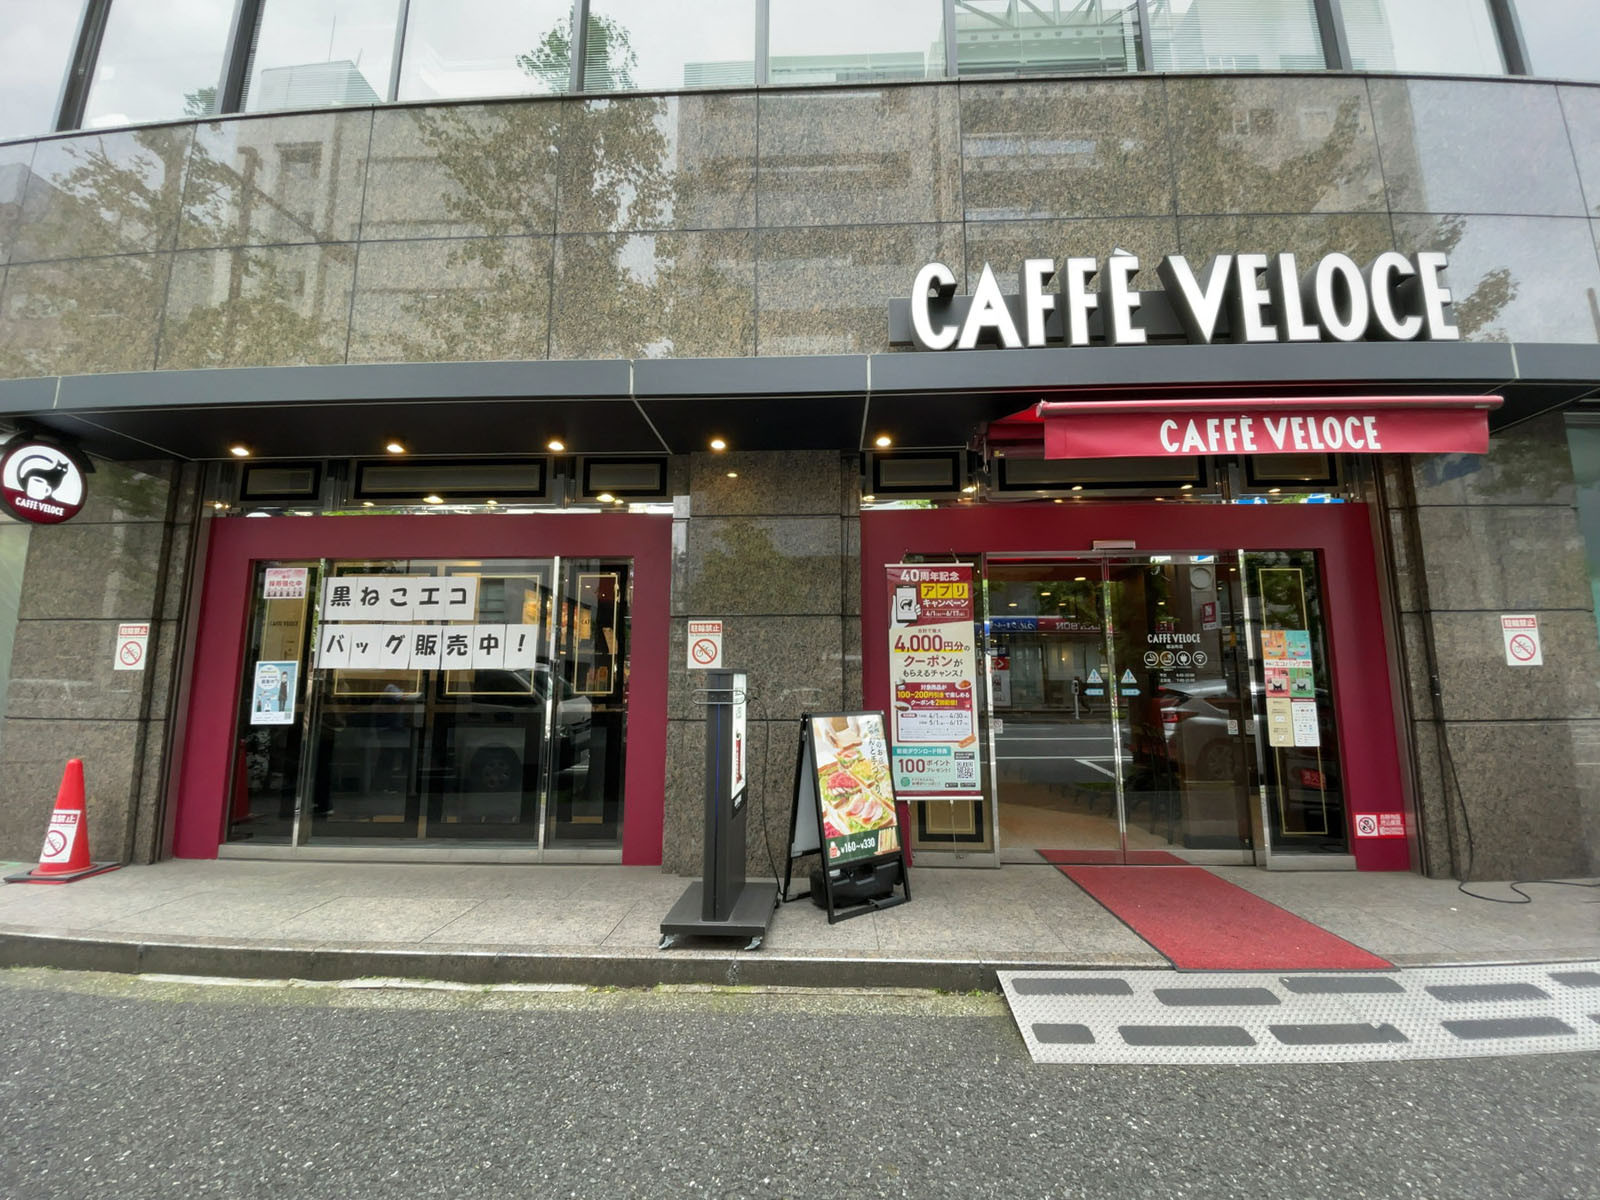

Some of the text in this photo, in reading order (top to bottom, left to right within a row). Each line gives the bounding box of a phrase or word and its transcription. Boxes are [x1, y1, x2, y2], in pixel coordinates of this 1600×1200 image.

[911, 247, 1460, 351] CAFFÈ VELOCE
[1160, 415, 1382, 452] CAFFÈ VELOCE
[38, 502, 64, 516] VELOCE
[900, 569, 960, 582] 40周年記念
[330, 585, 467, 607] 黒ねこエコ
[922, 584, 966, 597] アプリ
[922, 599, 969, 607] キャンペーン
[894, 634, 971, 652] 4,000円分の
[1172, 633, 1201, 643] VELOCE
[904, 655, 964, 668] クーポンが
[898, 758, 926, 774] 100
[926, 759, 951, 767] ポイント
